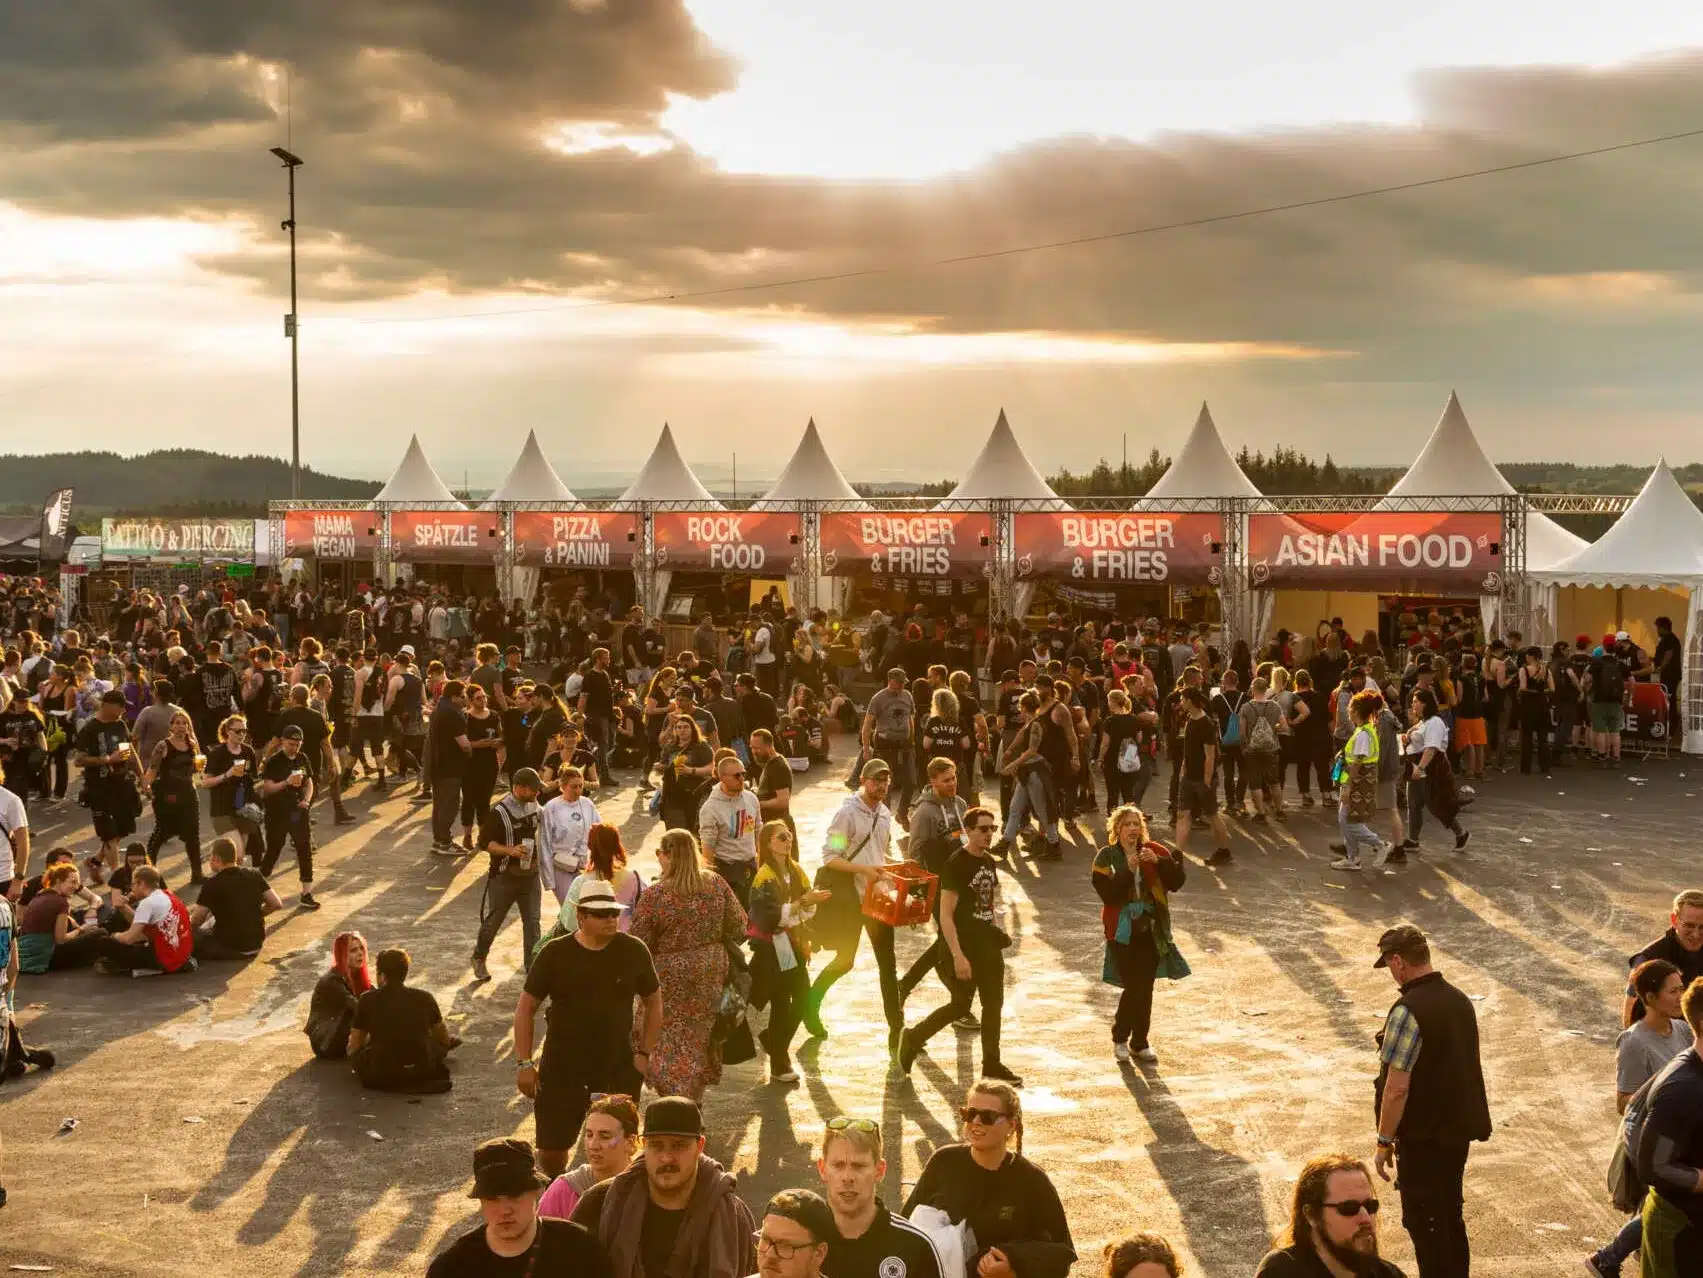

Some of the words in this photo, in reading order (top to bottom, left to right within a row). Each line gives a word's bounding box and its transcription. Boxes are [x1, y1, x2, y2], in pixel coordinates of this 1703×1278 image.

[57, 489, 73, 539] ATTICUS
[314, 515, 354, 535] MAMA
[103, 524, 164, 550] TATTOO
[168, 529, 179, 550] &
[180, 524, 254, 551] PIERCING
[415, 520, 478, 546] SPÄTZLE
[553, 517, 602, 541] PIZZA
[688, 517, 743, 541] ROCK
[862, 518, 955, 545] BURGER
[1062, 519, 1174, 548] BURGER
[313, 537, 355, 558] VEGAN
[545, 548, 553, 564] &
[557, 542, 610, 566] PANINI
[710, 545, 765, 570] FOOD
[1276, 535, 1369, 566] ASIAN
[1379, 535, 1472, 568] FOOD
[871, 552, 882, 573] &
[888, 547, 950, 575] FRIES
[1071, 555, 1085, 578] &
[1093, 550, 1168, 581] FRIES
